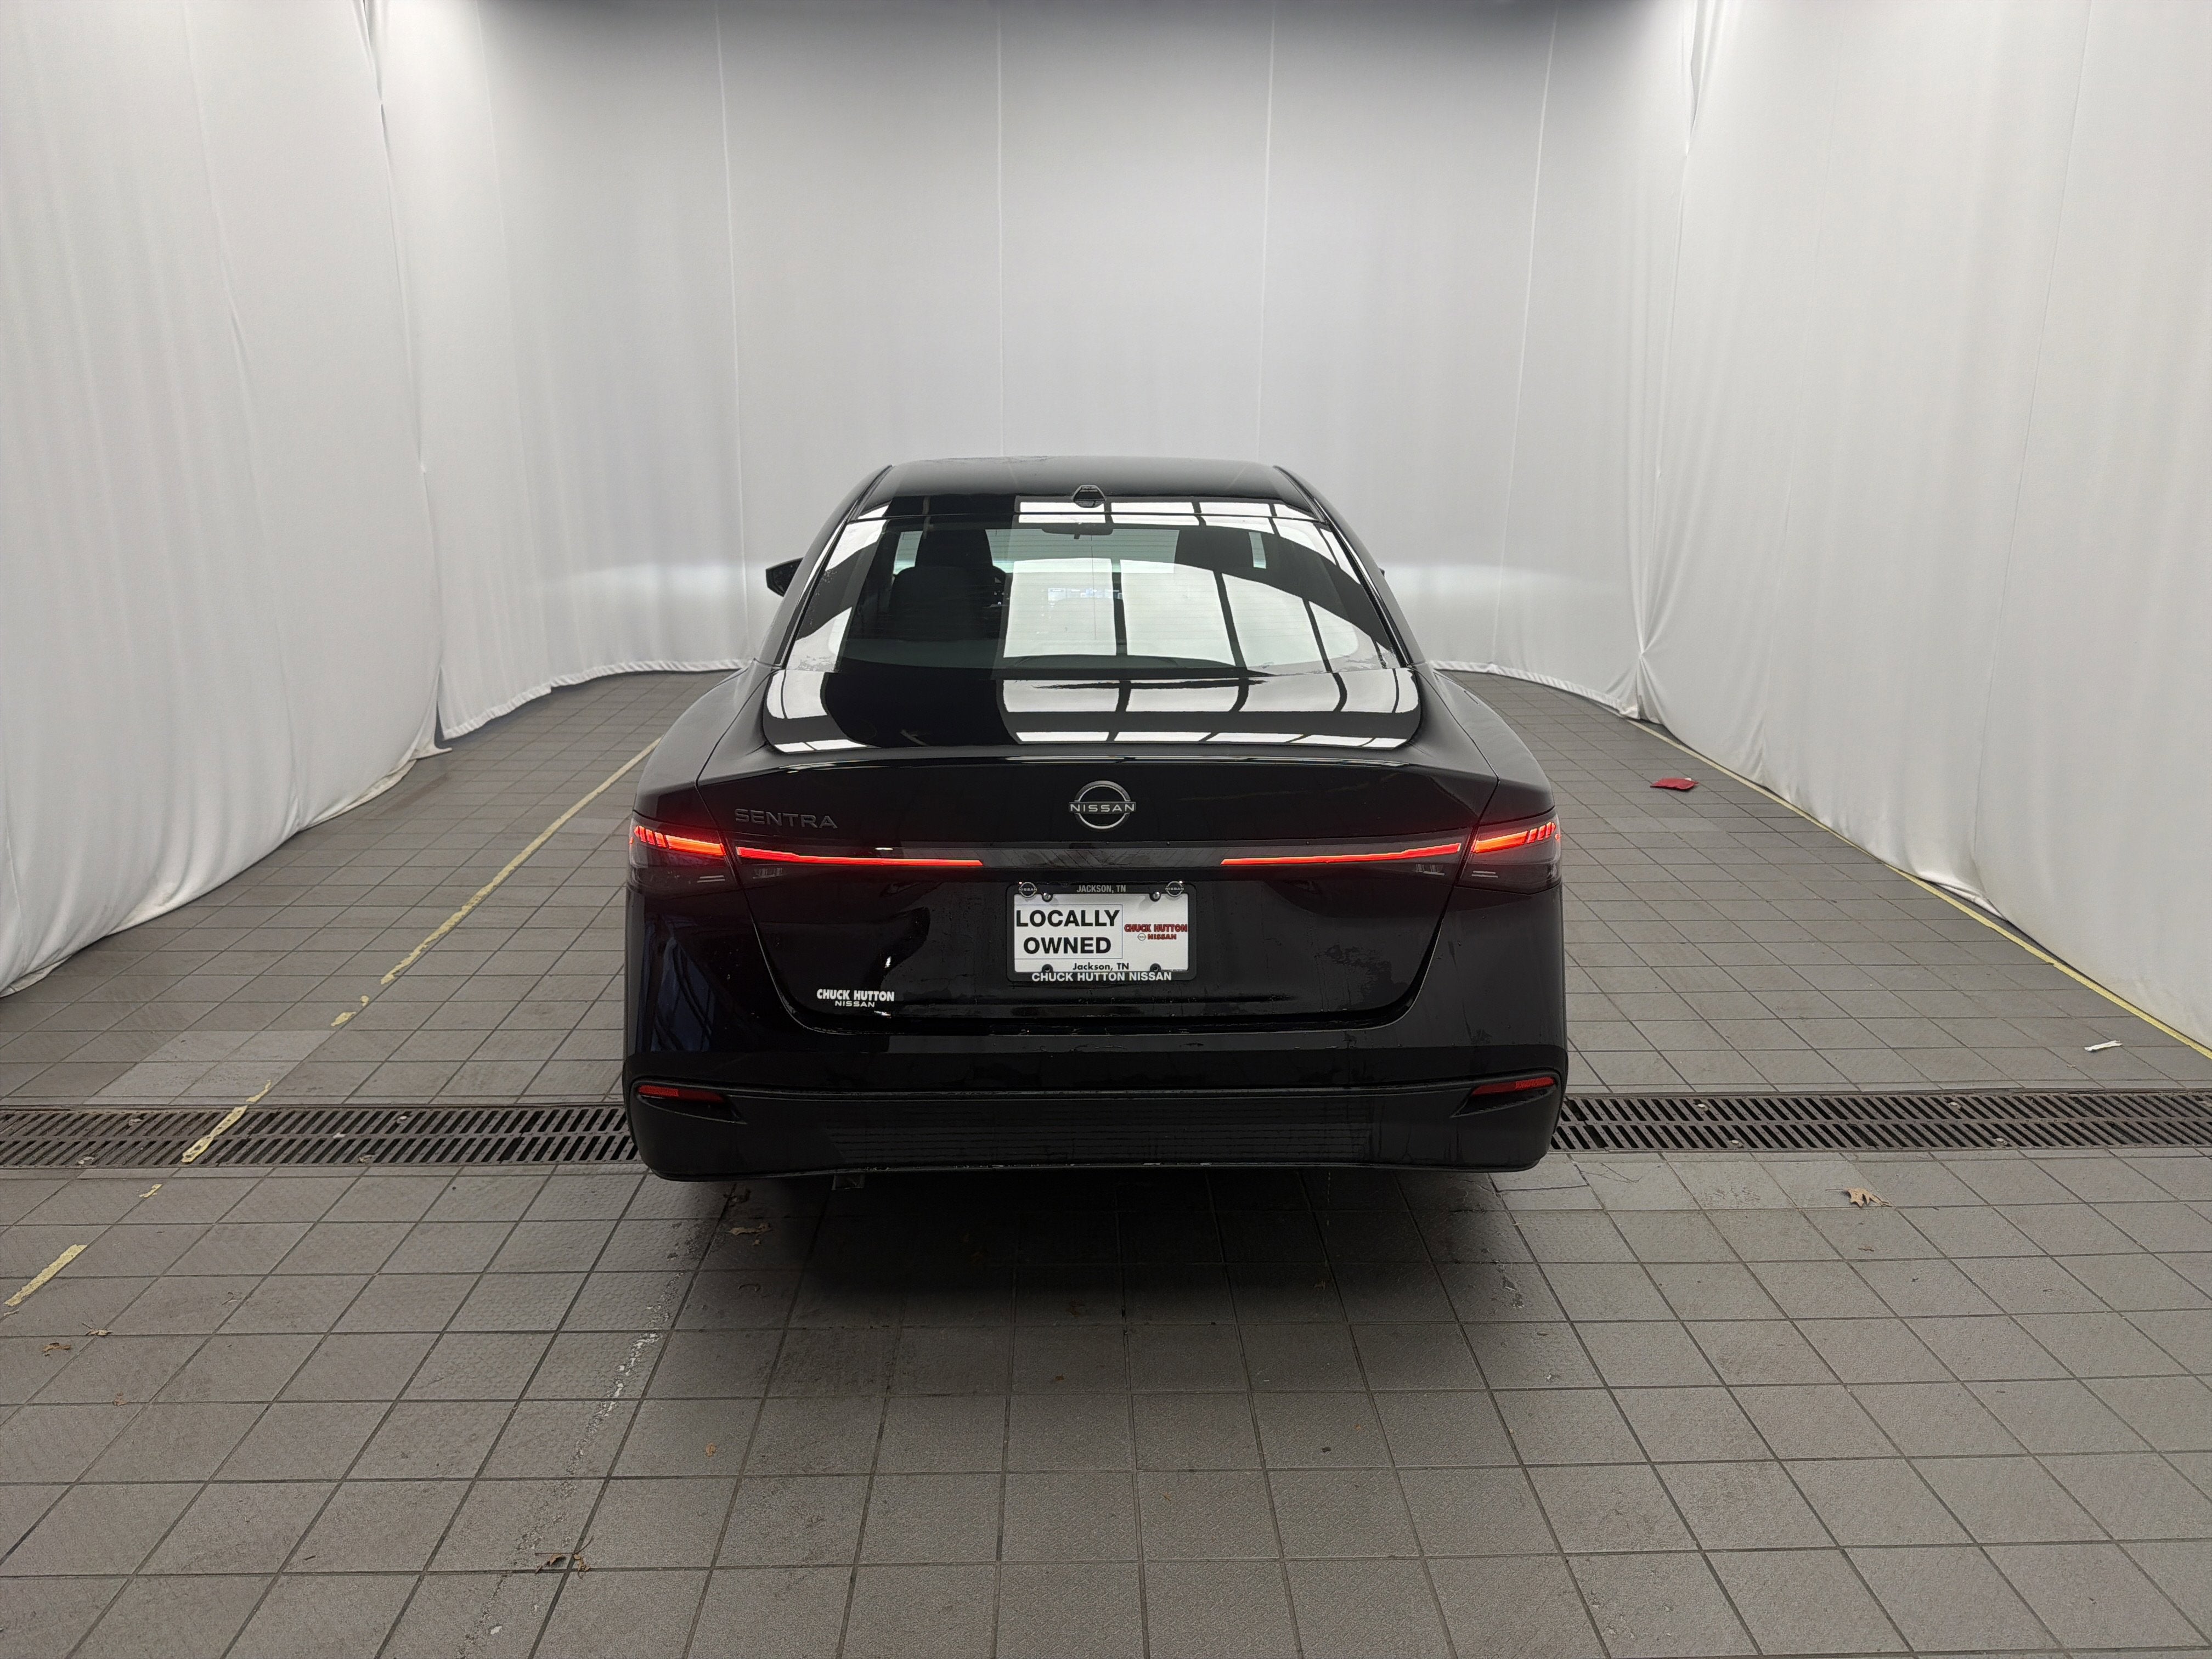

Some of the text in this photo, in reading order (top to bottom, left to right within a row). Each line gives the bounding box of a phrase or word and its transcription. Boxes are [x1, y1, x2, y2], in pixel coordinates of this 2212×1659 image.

[1070, 804, 1135, 812] NISSAN
[735, 808, 838, 829] SENTRA
[1076, 884, 1126, 894] JACKSON, TN
[1016, 910, 1120, 927] LOCALLY
[1124, 924, 1188, 932] CHUCK HUTTON
[1023, 936, 1111, 954] OWNED
[1073, 962, 1113, 971] Jackson,
[1031, 972, 1172, 981] CHUCK HUTTON NISSAN
[817, 989, 895, 1001] CHUCK HUTTON
